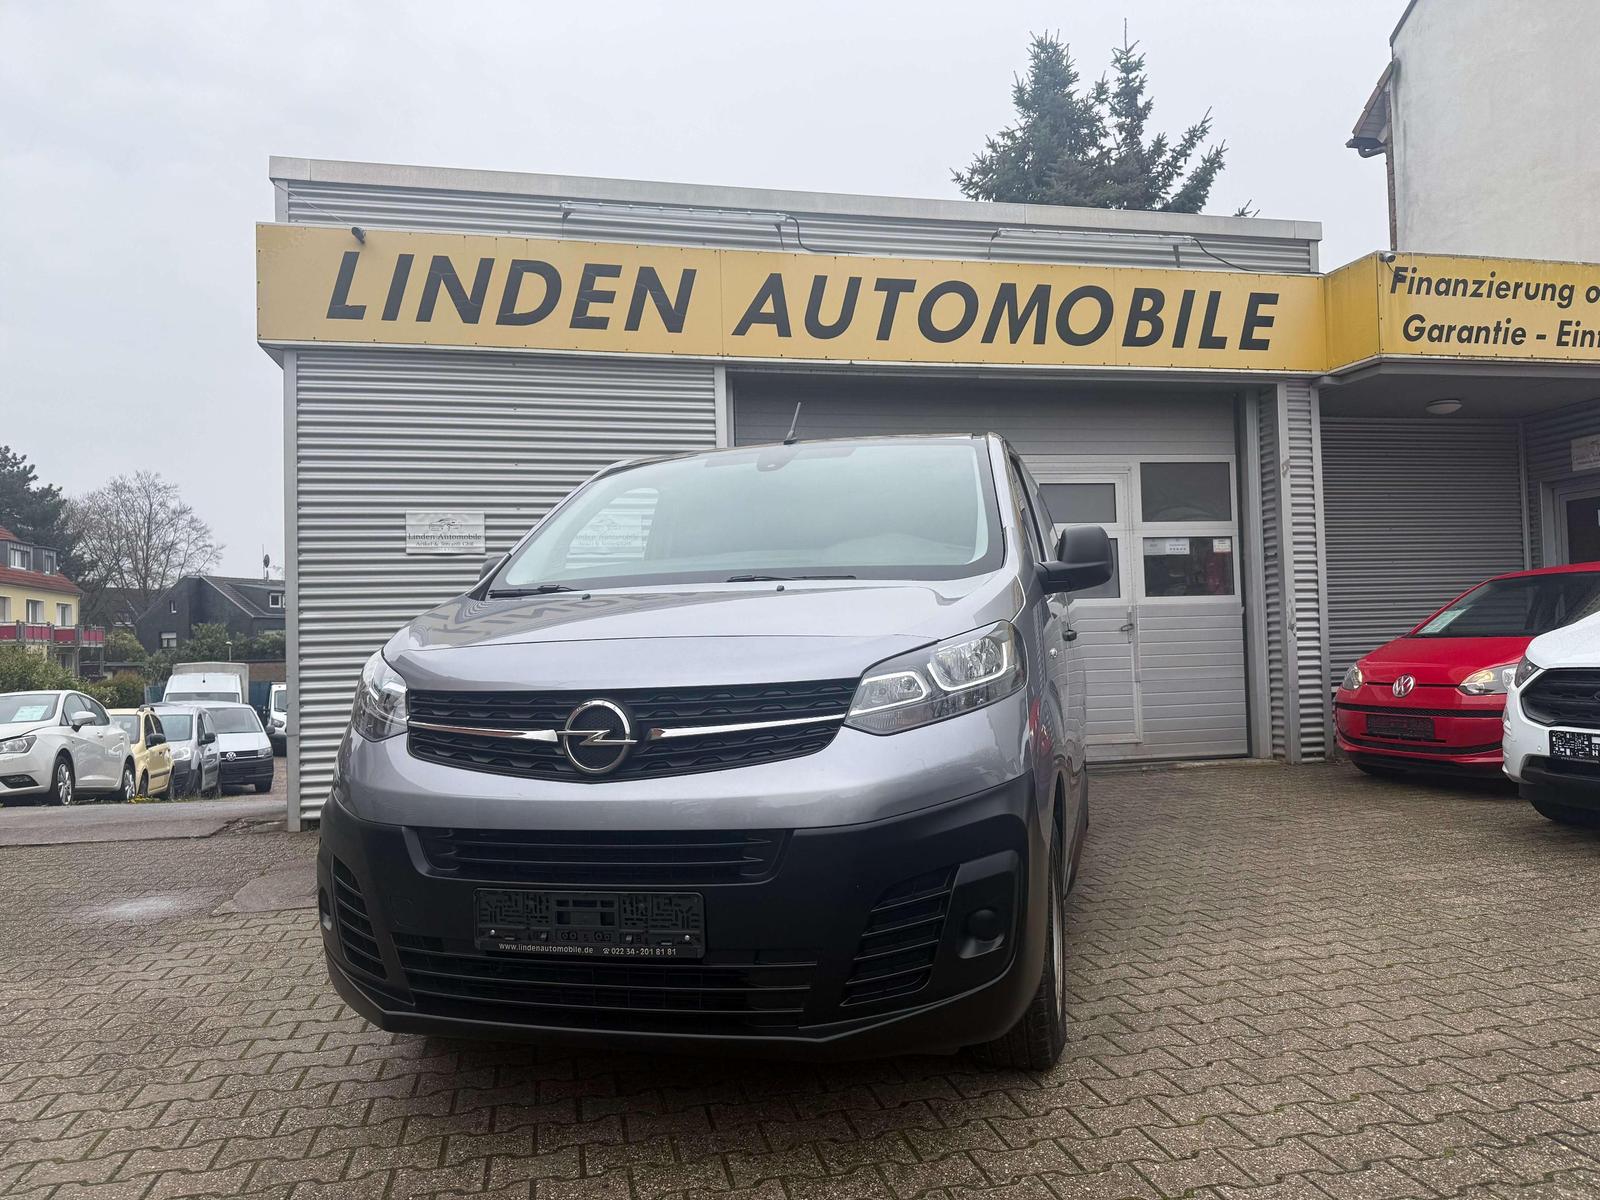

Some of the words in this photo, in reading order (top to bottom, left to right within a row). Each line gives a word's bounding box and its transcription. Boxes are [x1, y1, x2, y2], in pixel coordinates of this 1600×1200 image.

[326, 251, 697, 333] LINDEN
[731, 273, 1280, 351] AUTOMOBILE
[1390, 266, 1575, 309] Finanzierung
[1403, 313, 1527, 346] Garantie
[407, 532, 436, 541] Linden
[437, 533, 482, 542] Automobile
[498, 943, 594, 955] www.lindenautomobile.de
